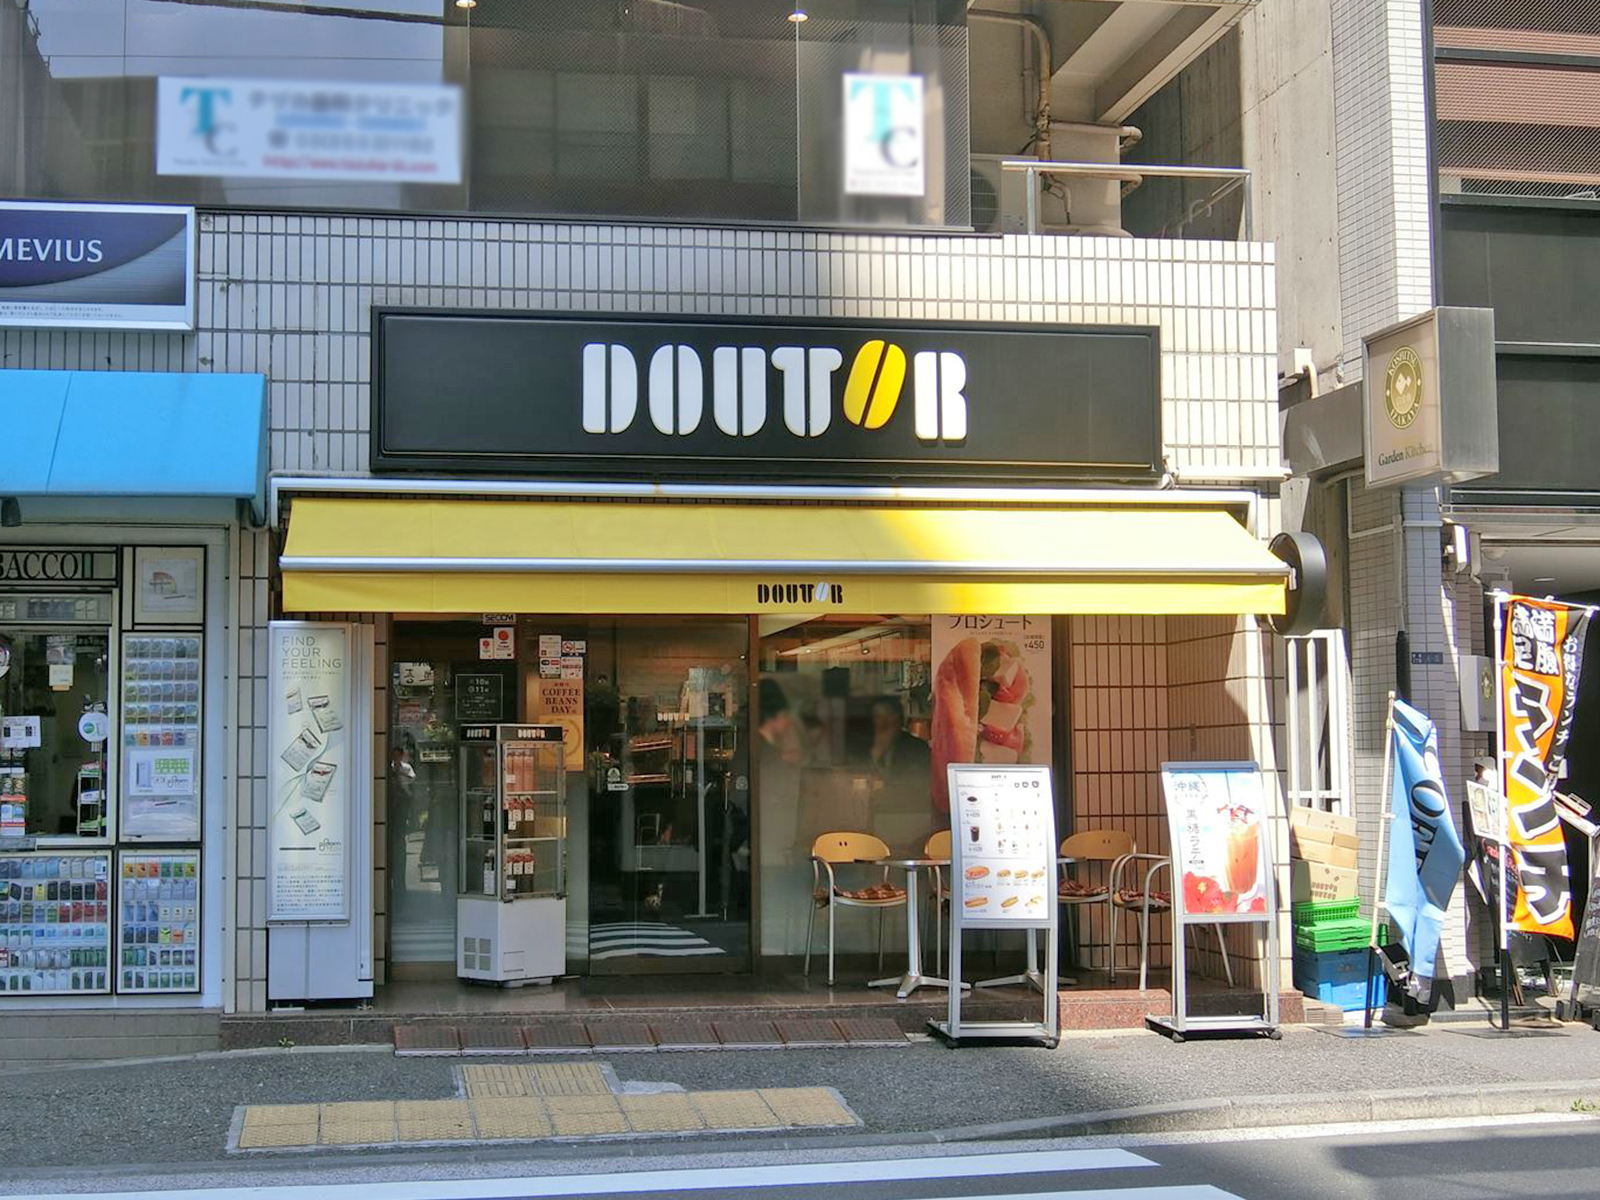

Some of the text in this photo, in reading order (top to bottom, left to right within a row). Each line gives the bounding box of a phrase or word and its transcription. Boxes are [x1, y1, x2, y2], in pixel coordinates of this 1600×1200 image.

[582, 339, 968, 441] DOUTOR
[1378, 450, 1404, 466] Garden
[757, 582, 843, 604] DOUTOR
[282, 636, 316, 647] FIND
[1024, 640, 1045, 649] ¥450
[281, 648, 321, 658] YOUR
[282, 659, 342, 669] FEELING
[542, 688, 581, 697] COFFEE
[545, 697, 578, 706] BEANS
[551, 706, 572, 714] DAY
